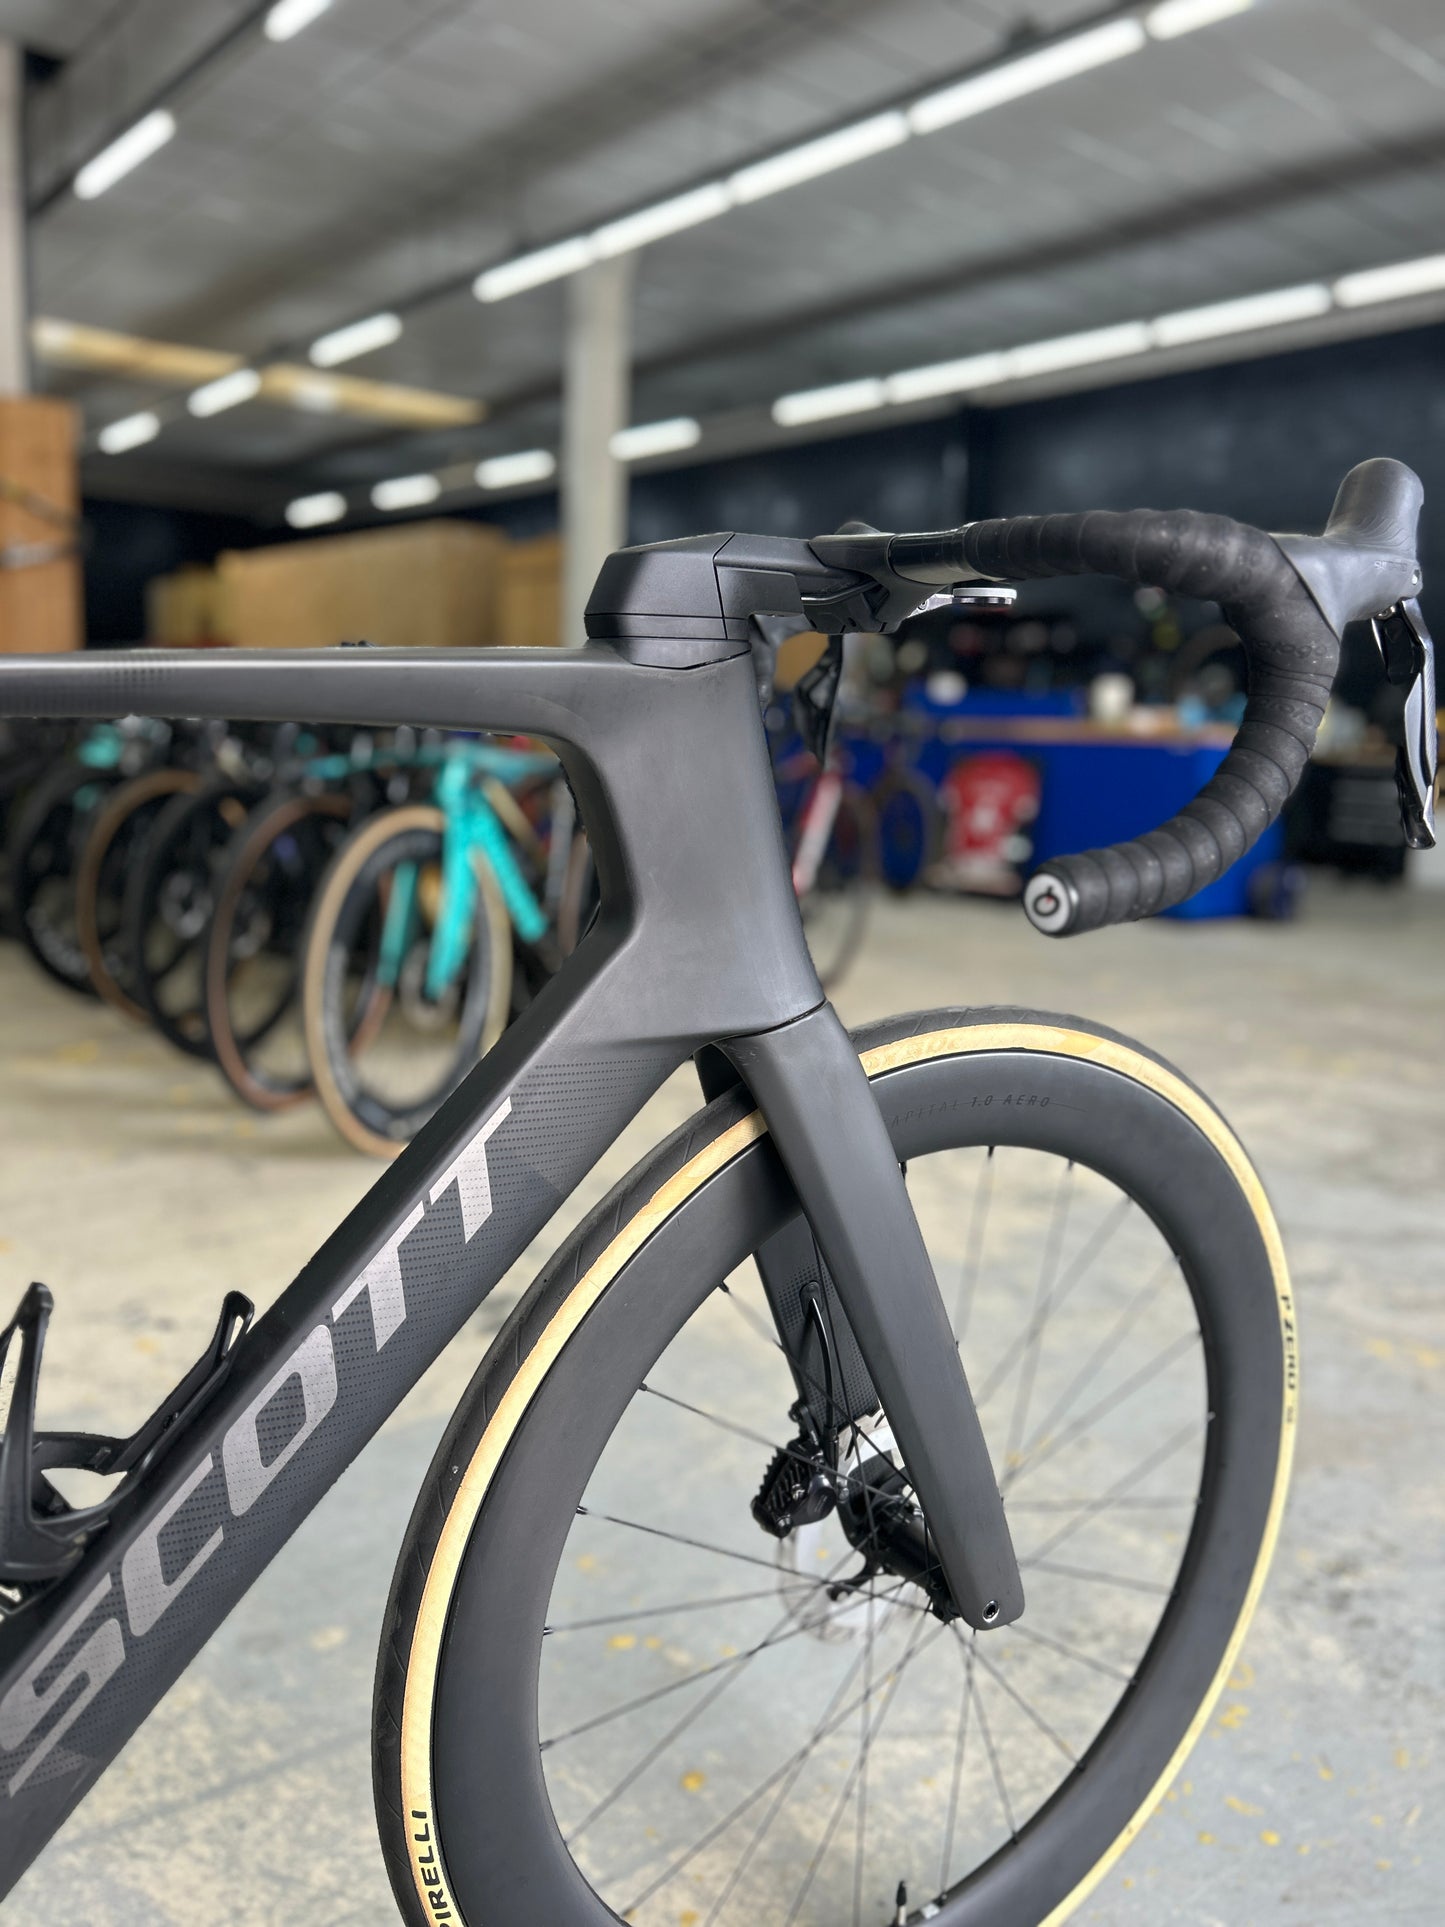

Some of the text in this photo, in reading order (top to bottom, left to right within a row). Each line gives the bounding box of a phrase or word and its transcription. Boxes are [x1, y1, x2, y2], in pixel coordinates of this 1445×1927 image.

[884, 1094, 1050, 1128] APITAL 1.0 AERO
[0, 1095, 512, 1798] SCOTT
